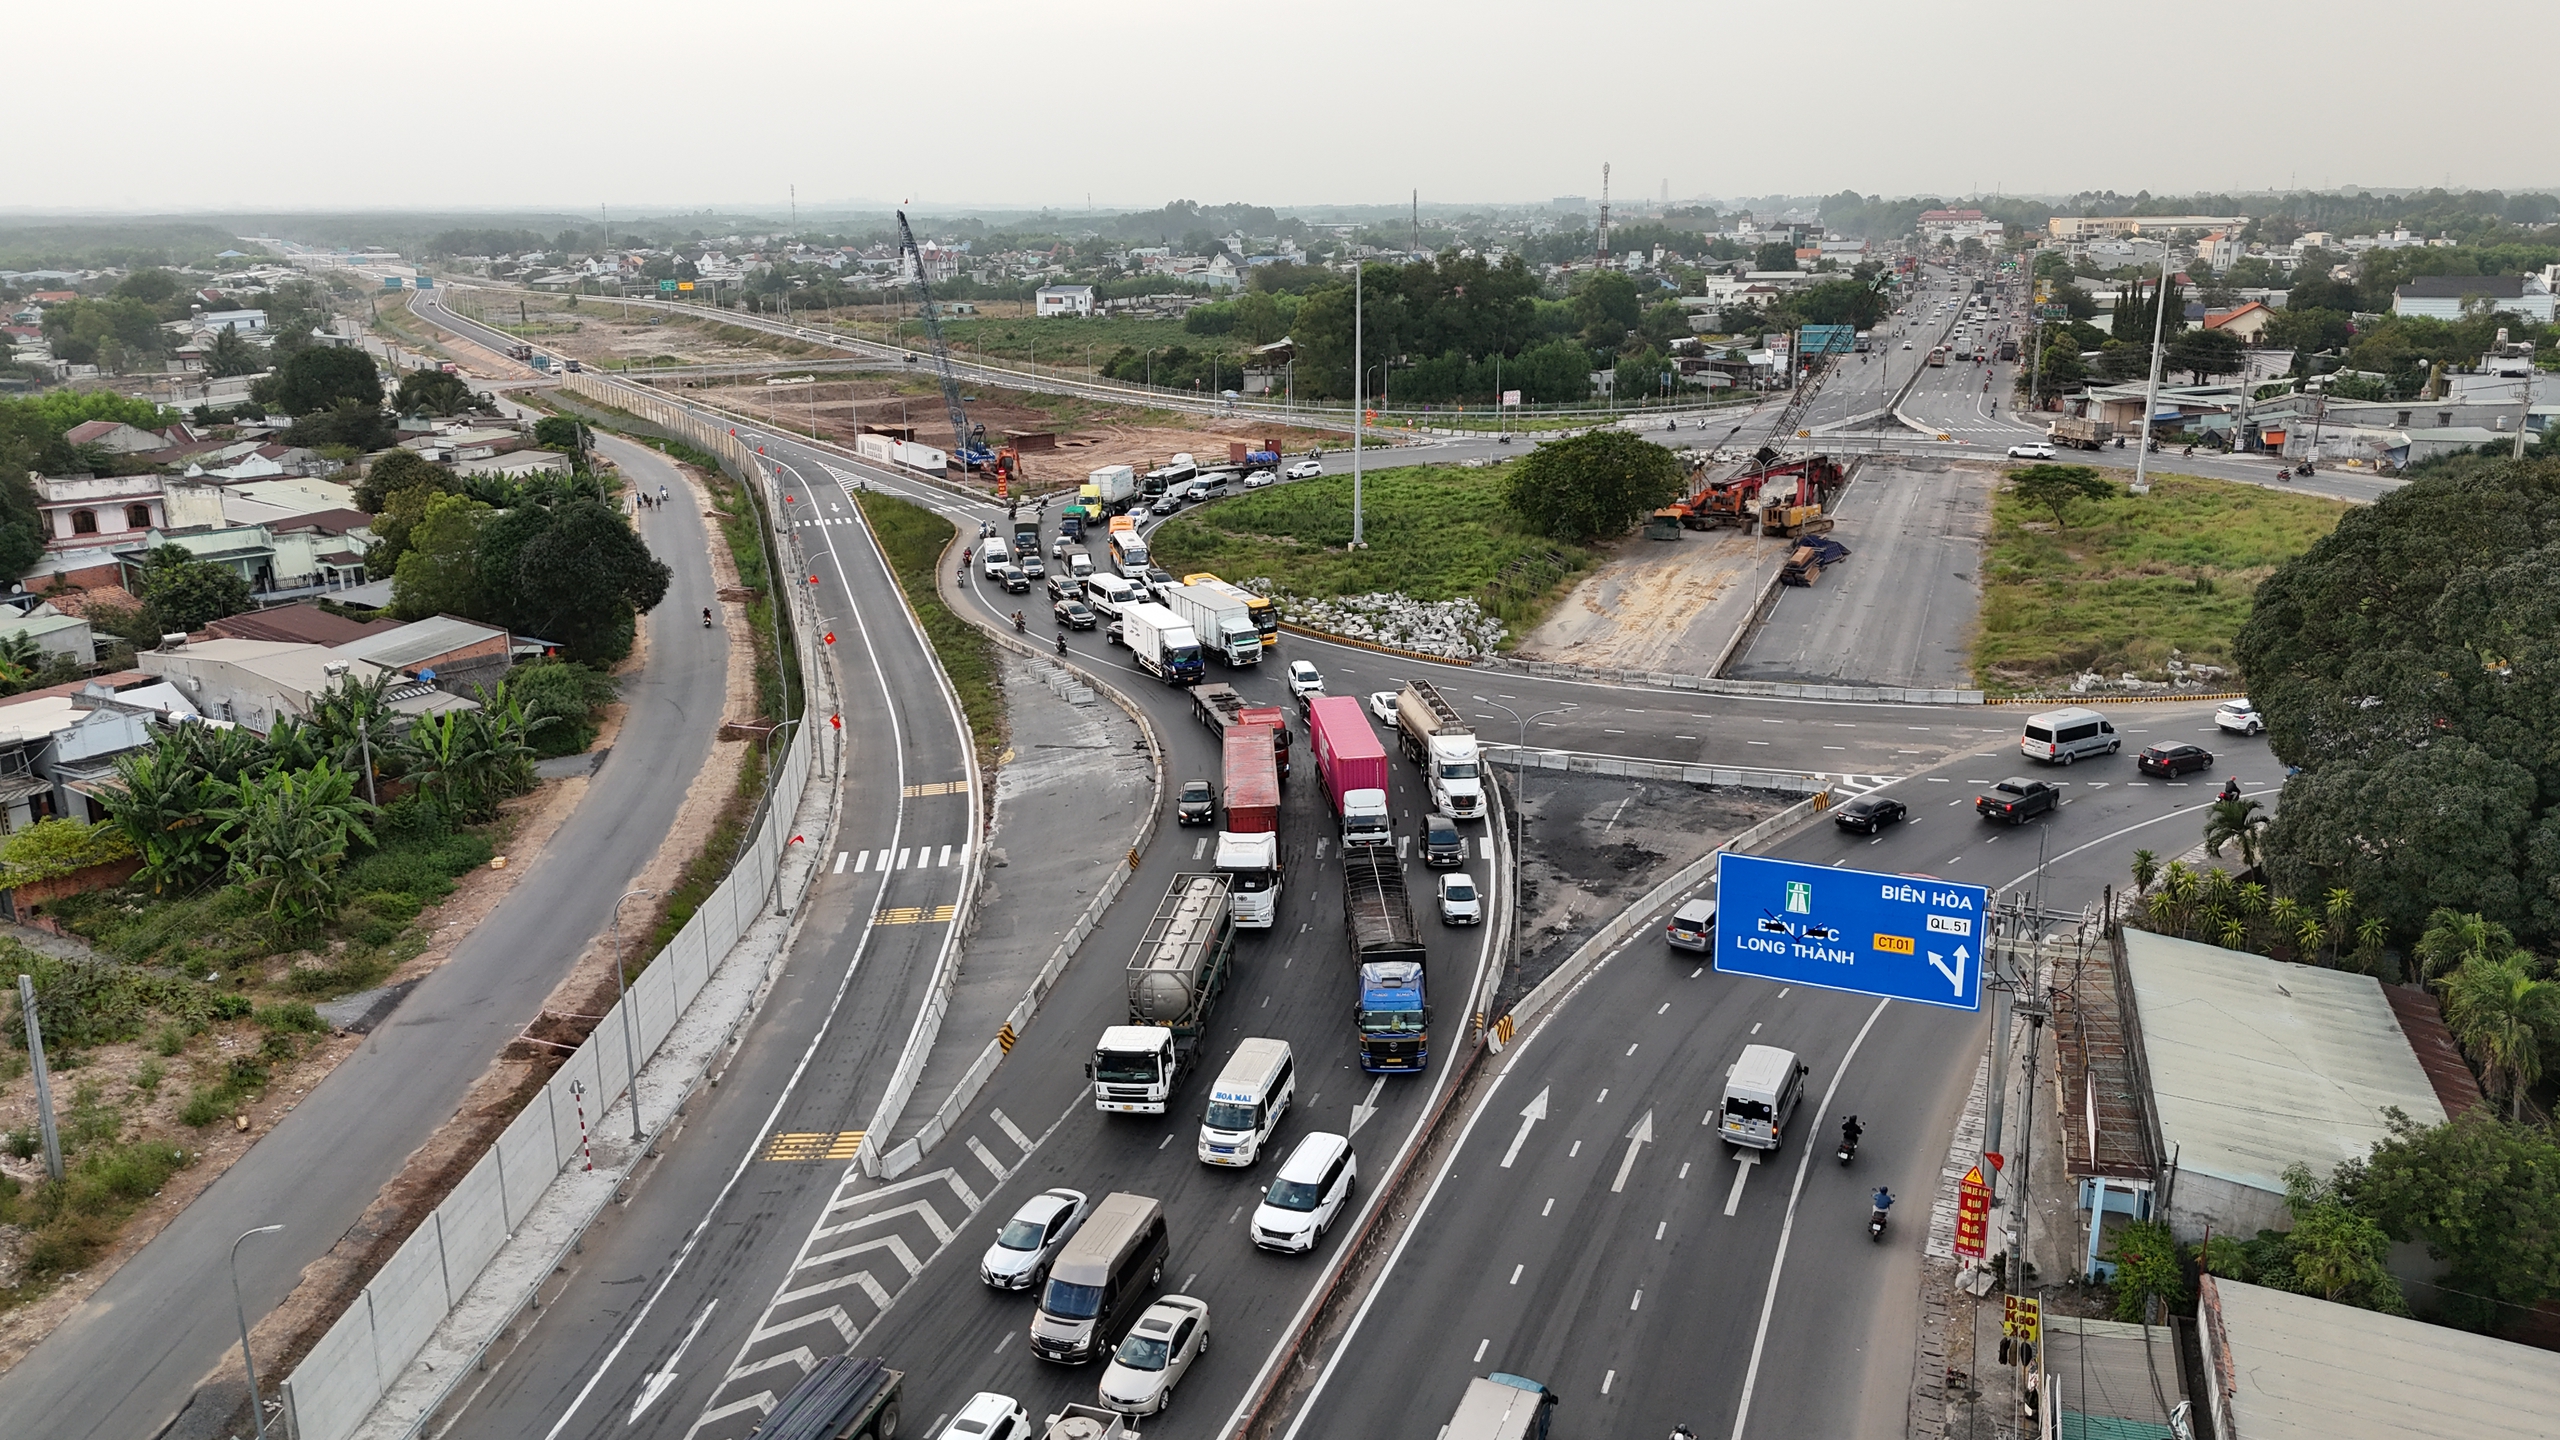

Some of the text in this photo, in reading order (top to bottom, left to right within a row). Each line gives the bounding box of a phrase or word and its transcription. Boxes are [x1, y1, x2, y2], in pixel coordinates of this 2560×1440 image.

[1881, 884, 1973, 911] BIÊN HÒA
[1930, 917, 1967, 933] QL.51
[1737, 935, 1855, 965] LONG THÀNH
[1878, 936, 1909, 951] CT.01
[1215, 1092, 1252, 1102] HOA MAI
[2005, 1309, 2036, 1326] Keo
[2010, 1323, 2030, 1340] Xe
